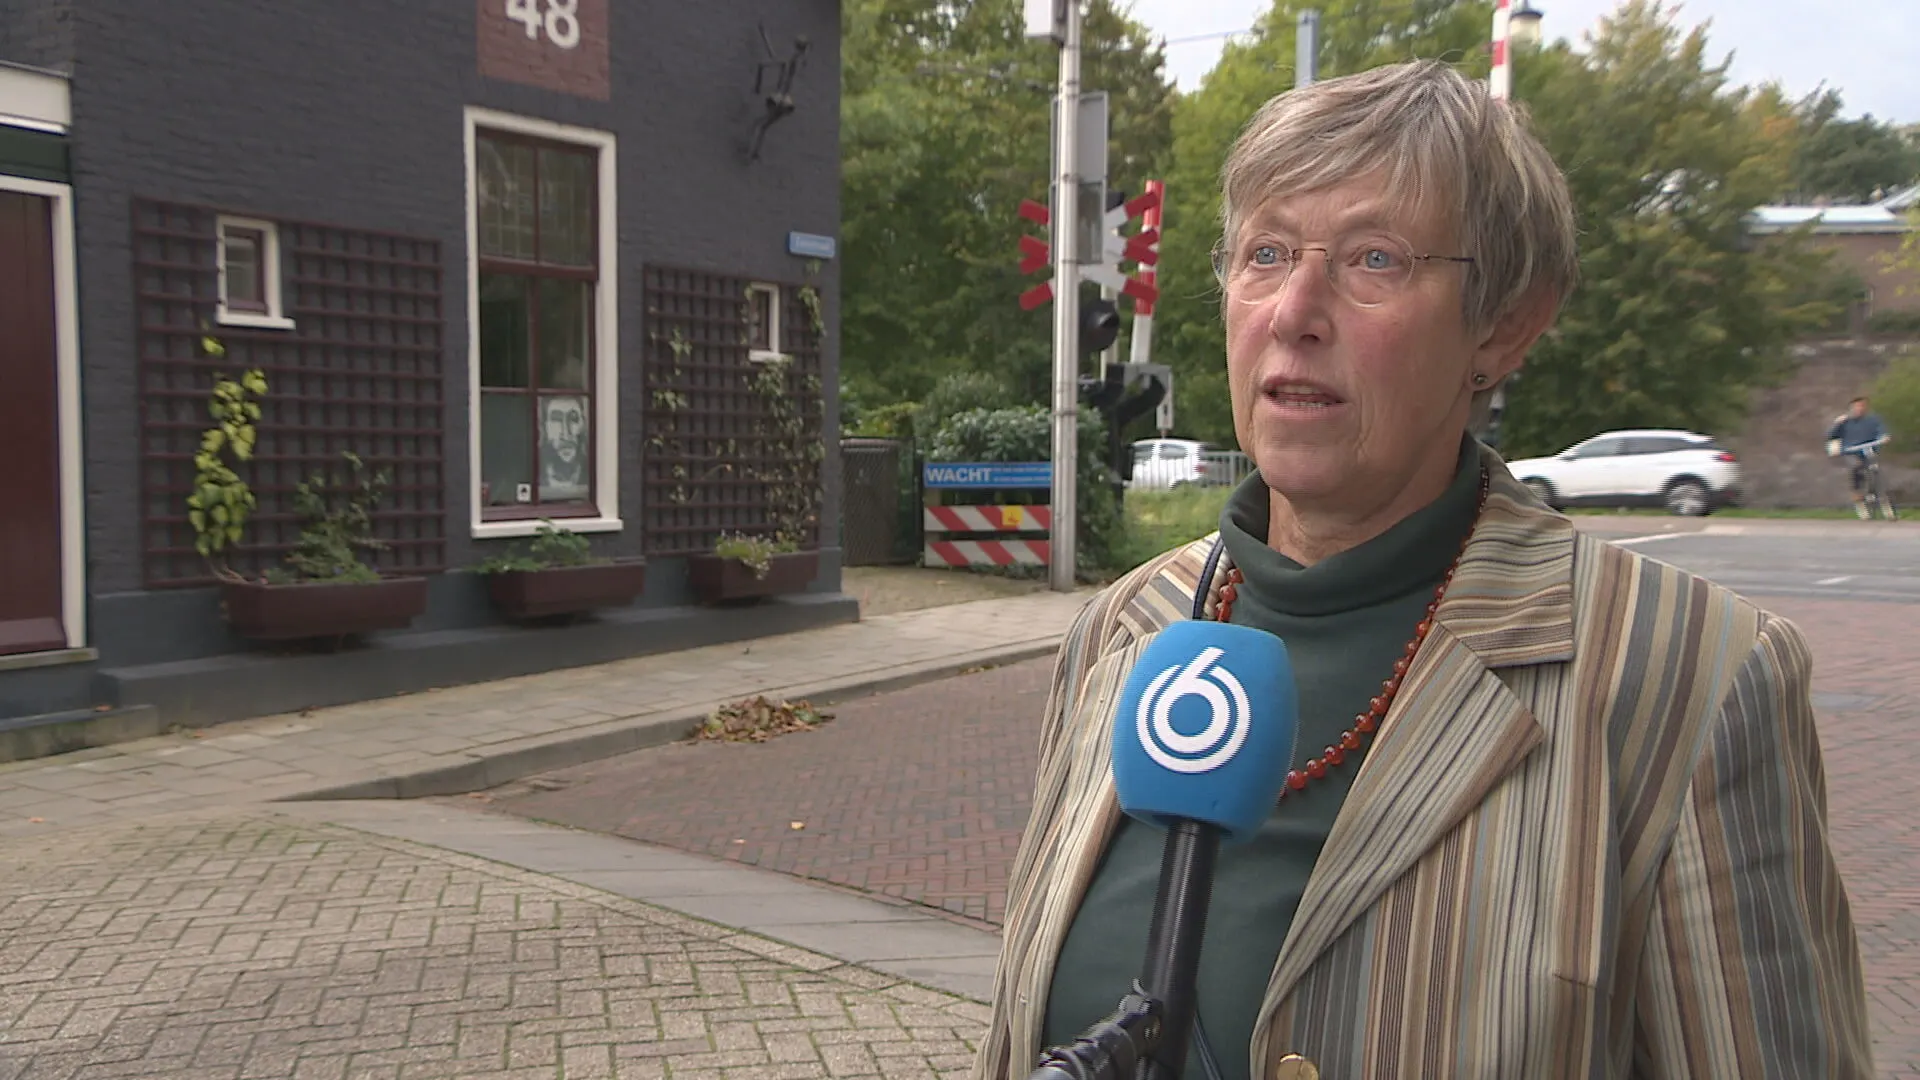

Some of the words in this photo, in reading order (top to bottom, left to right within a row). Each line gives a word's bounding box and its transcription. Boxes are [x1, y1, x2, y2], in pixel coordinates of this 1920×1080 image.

[505, 0, 580, 49] 48
[927, 467, 992, 482] WACHT
[1153, 646, 1232, 754] 6
